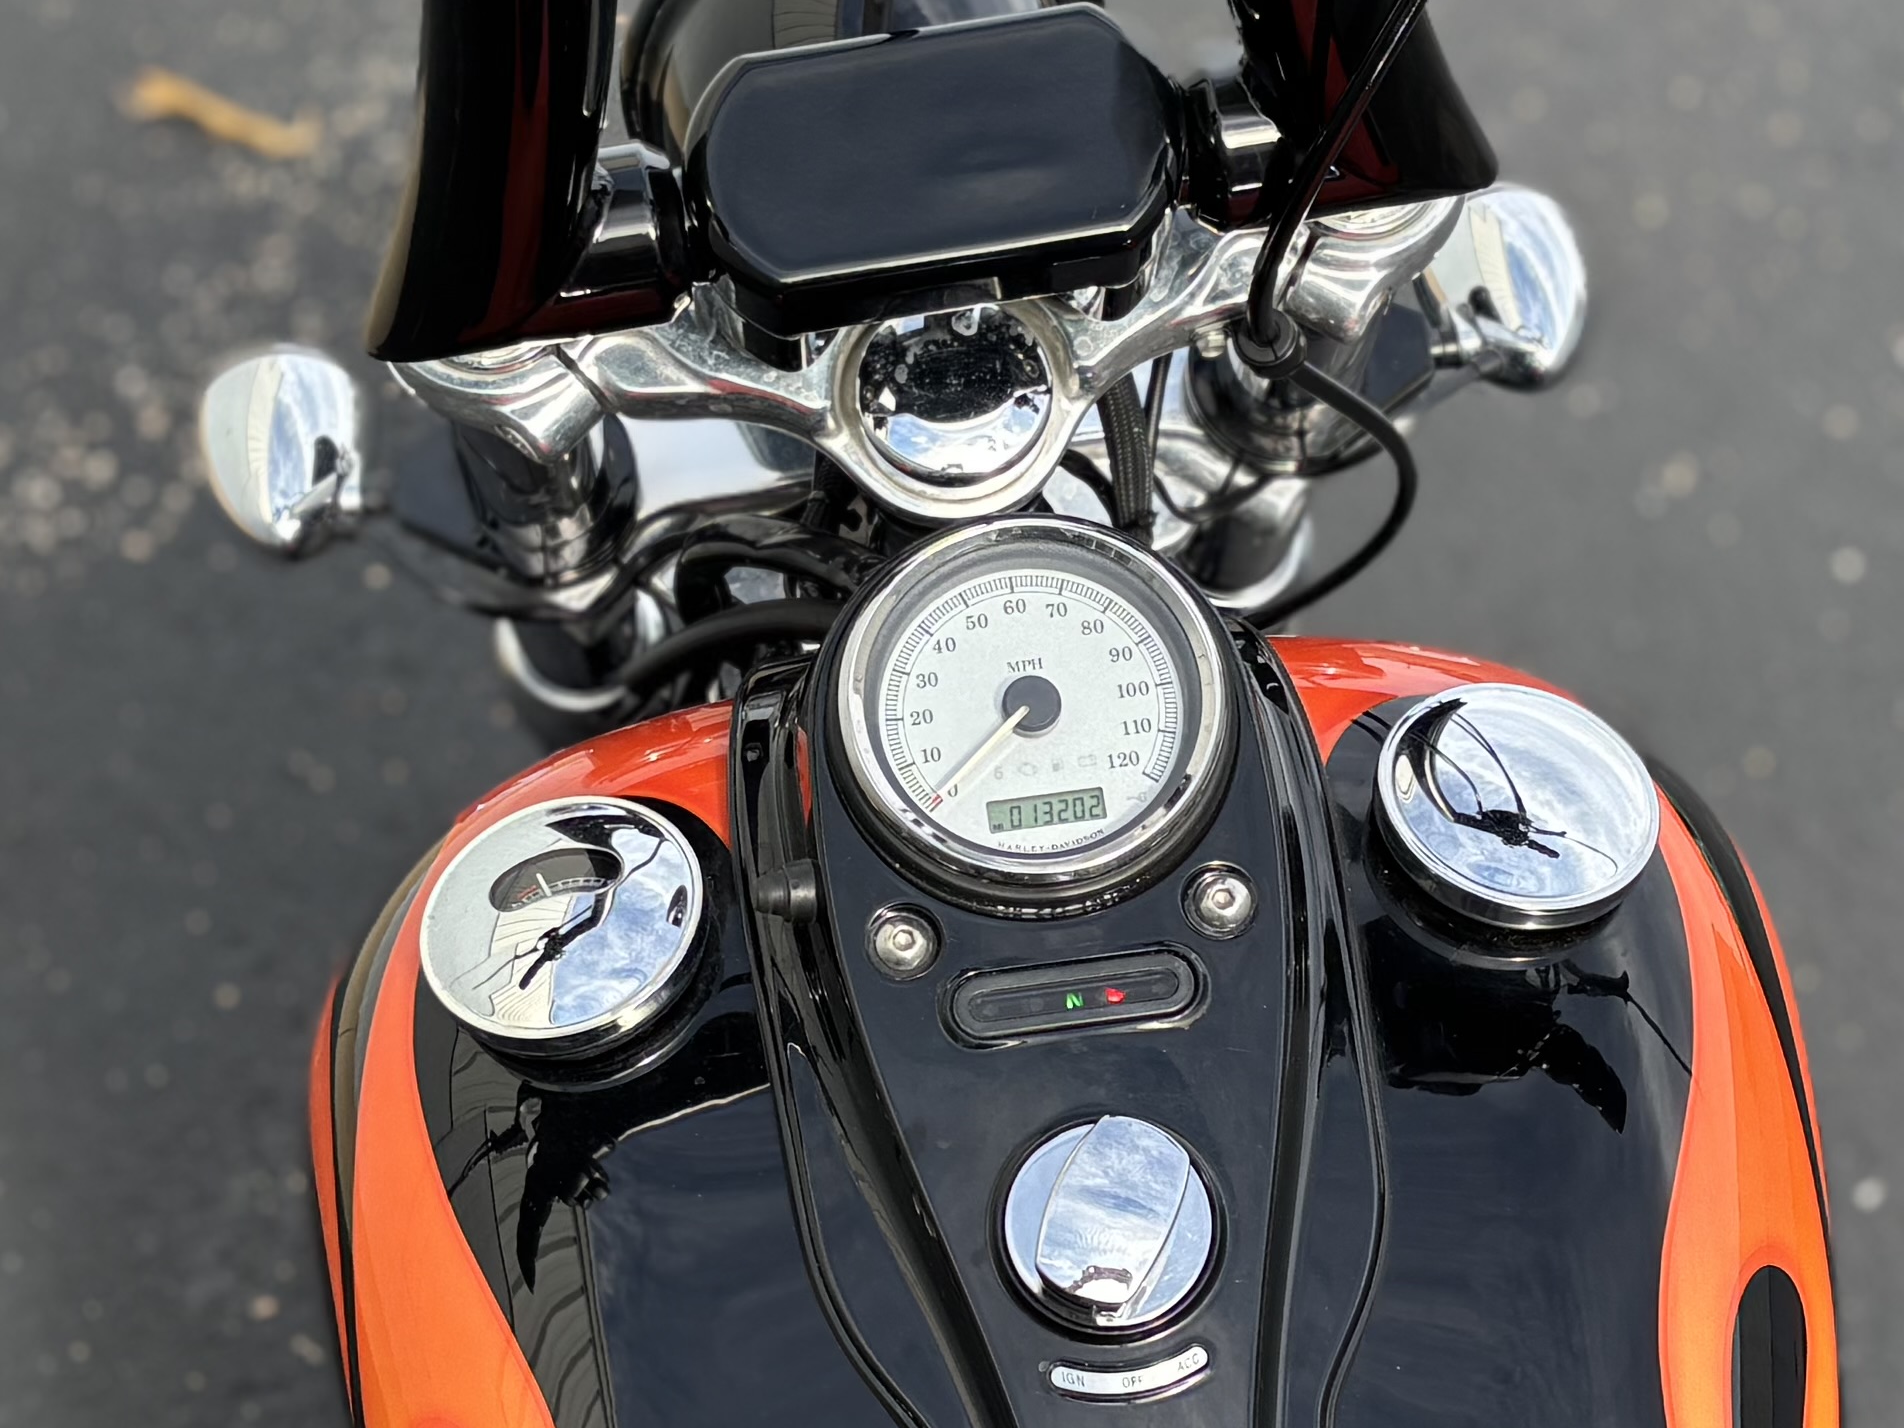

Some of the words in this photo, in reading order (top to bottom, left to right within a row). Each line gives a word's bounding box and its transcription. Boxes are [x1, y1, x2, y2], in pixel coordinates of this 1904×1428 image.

[1003, 598, 1027, 616] 60
[1046, 602, 1068, 619] 70
[965, 613, 989, 631] 50
[1081, 619, 1105, 636] 80
[933, 637, 956, 654] 40
[1109, 646, 1133, 663] 90
[1007, 657, 1044, 673] MPH
[916, 672, 939, 689] 30
[1117, 681, 1150, 699] 100
[909, 708, 934, 726] 20
[1122, 718, 1152, 736] 110
[920, 746, 942, 764] 10
[1107, 751, 1140, 770] 120
[1009, 794, 1101, 829] 013202
[998, 828, 1105, 853] HARLEY-DAVIDSON
[1066, 992, 1084, 1010] N
[1061, 1371, 1086, 1388] IGN
[1122, 1375, 1143, 1388] OFF
[1177, 1352, 1200, 1373] ACC
